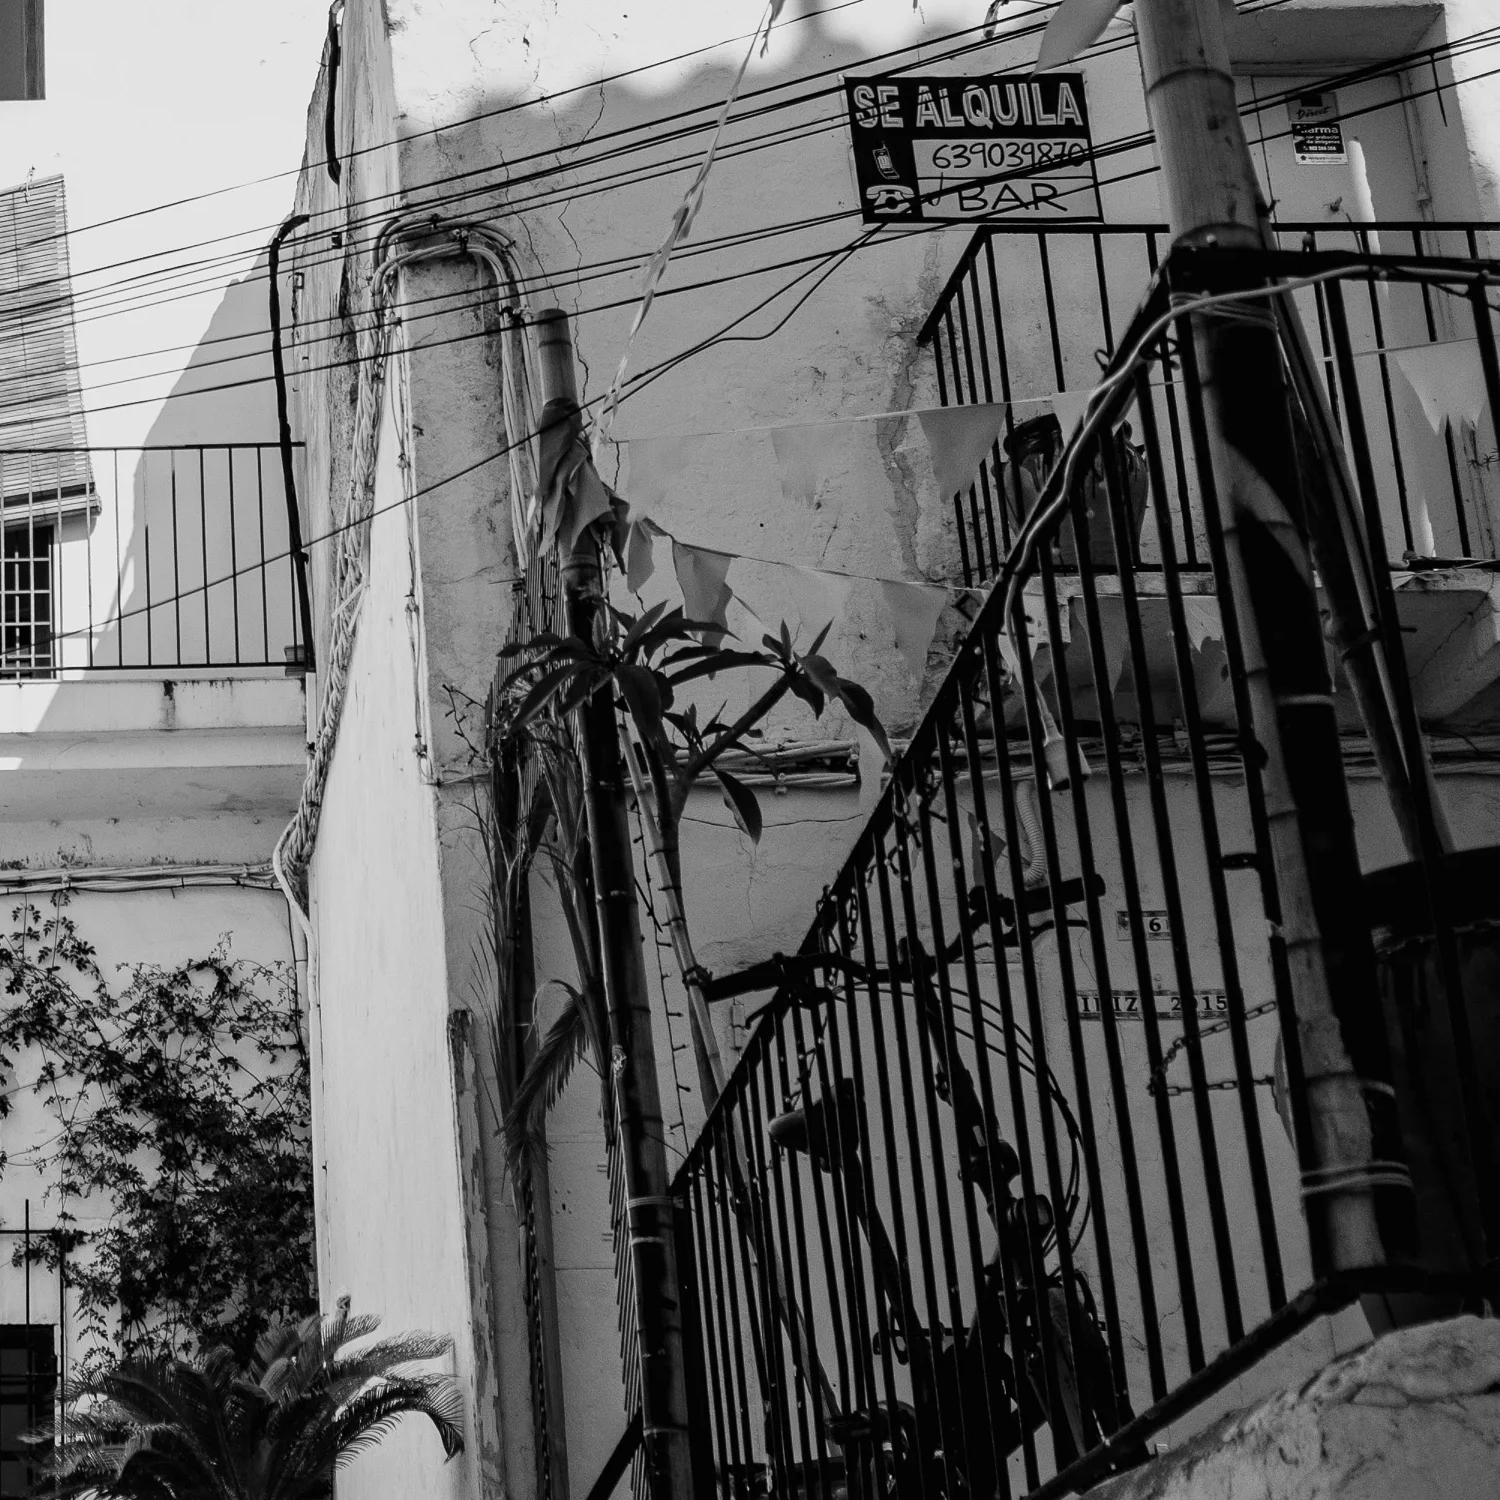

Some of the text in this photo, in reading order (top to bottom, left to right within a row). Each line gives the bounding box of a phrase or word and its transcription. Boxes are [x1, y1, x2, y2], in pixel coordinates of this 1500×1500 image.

[852, 81, 1084, 130] SE ALQUILA
[932, 141, 1085, 169] 639039870
[957, 182, 1068, 213] BAR
[1170, 994, 1228, 1012] 215
